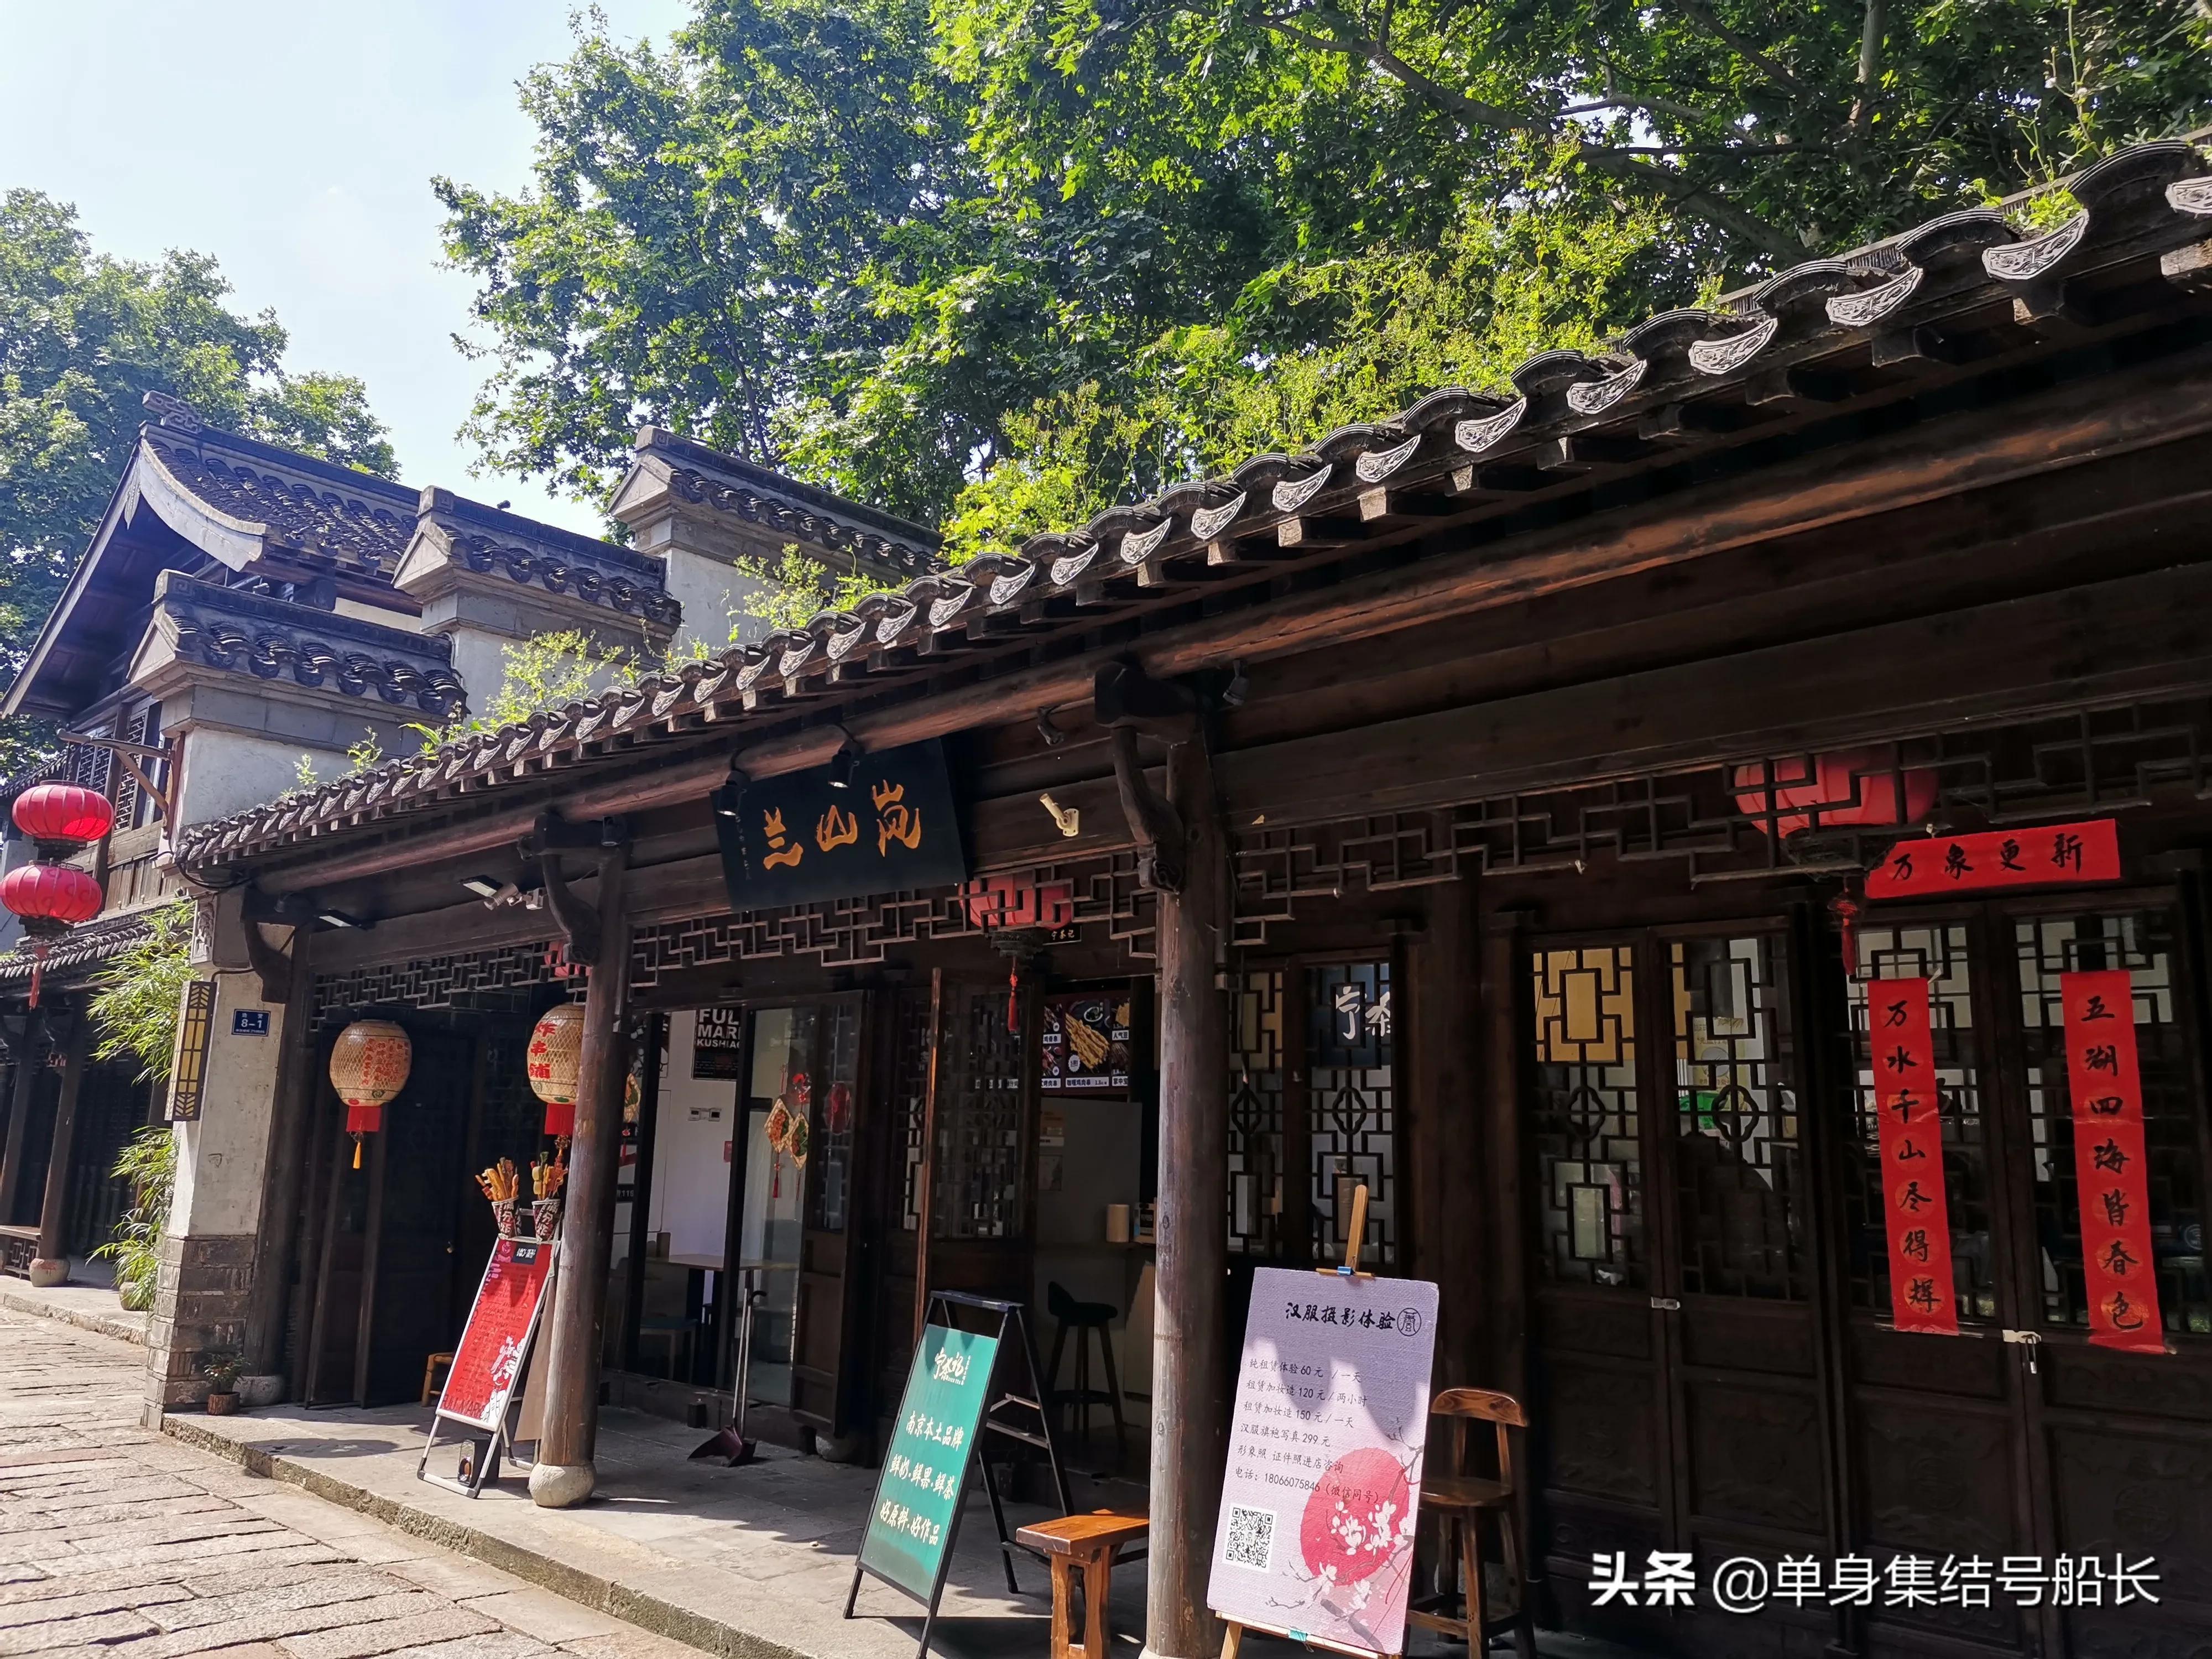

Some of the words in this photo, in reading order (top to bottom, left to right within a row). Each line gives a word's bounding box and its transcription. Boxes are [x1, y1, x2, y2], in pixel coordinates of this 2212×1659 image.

[1892, 833, 2084, 880] 万象更新
[698, 1024, 741, 1040] MAR
[1883, 1000, 1942, 1313] 万水千山尽得辉
[2080, 995, 2144, 1330] 五湖四海皆春色
[1285, 1302, 1396, 1330] 汉服摄影体验
[906, 1410, 964, 1452] 南京本土品牌
[1237, 1444, 1267, 1459] 形象照
[1272, 1451, 1344, 1474] 证件照进店咨询
